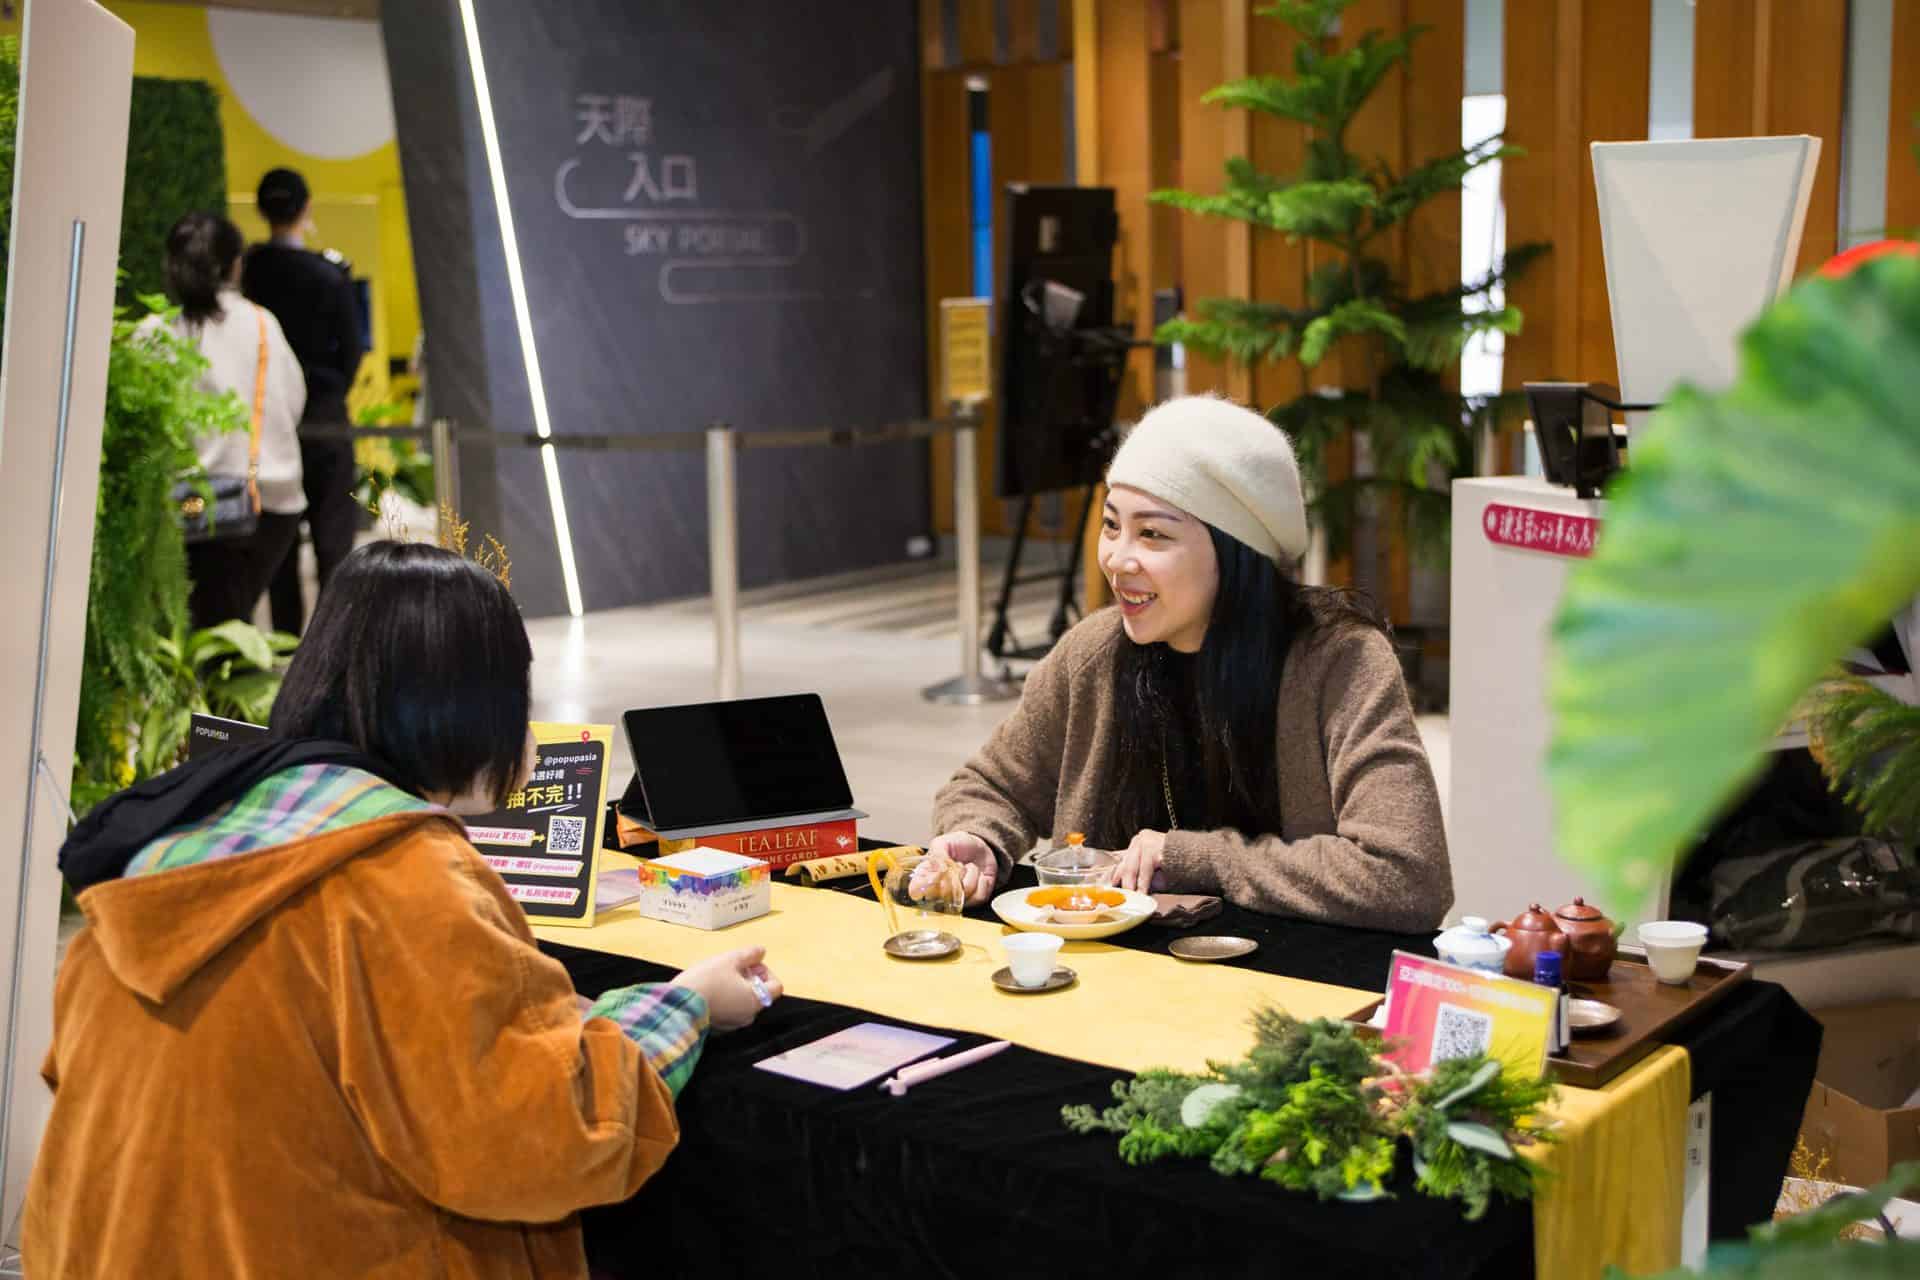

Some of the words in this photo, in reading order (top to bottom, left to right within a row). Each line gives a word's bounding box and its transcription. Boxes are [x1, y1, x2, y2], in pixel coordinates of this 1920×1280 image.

[576, 94, 653, 147] 天際
[623, 152, 698, 201] 入口
[544, 753, 597, 766] @popupasia
[736, 836, 771, 854] TEA
[774, 830, 818, 849] LEAF
